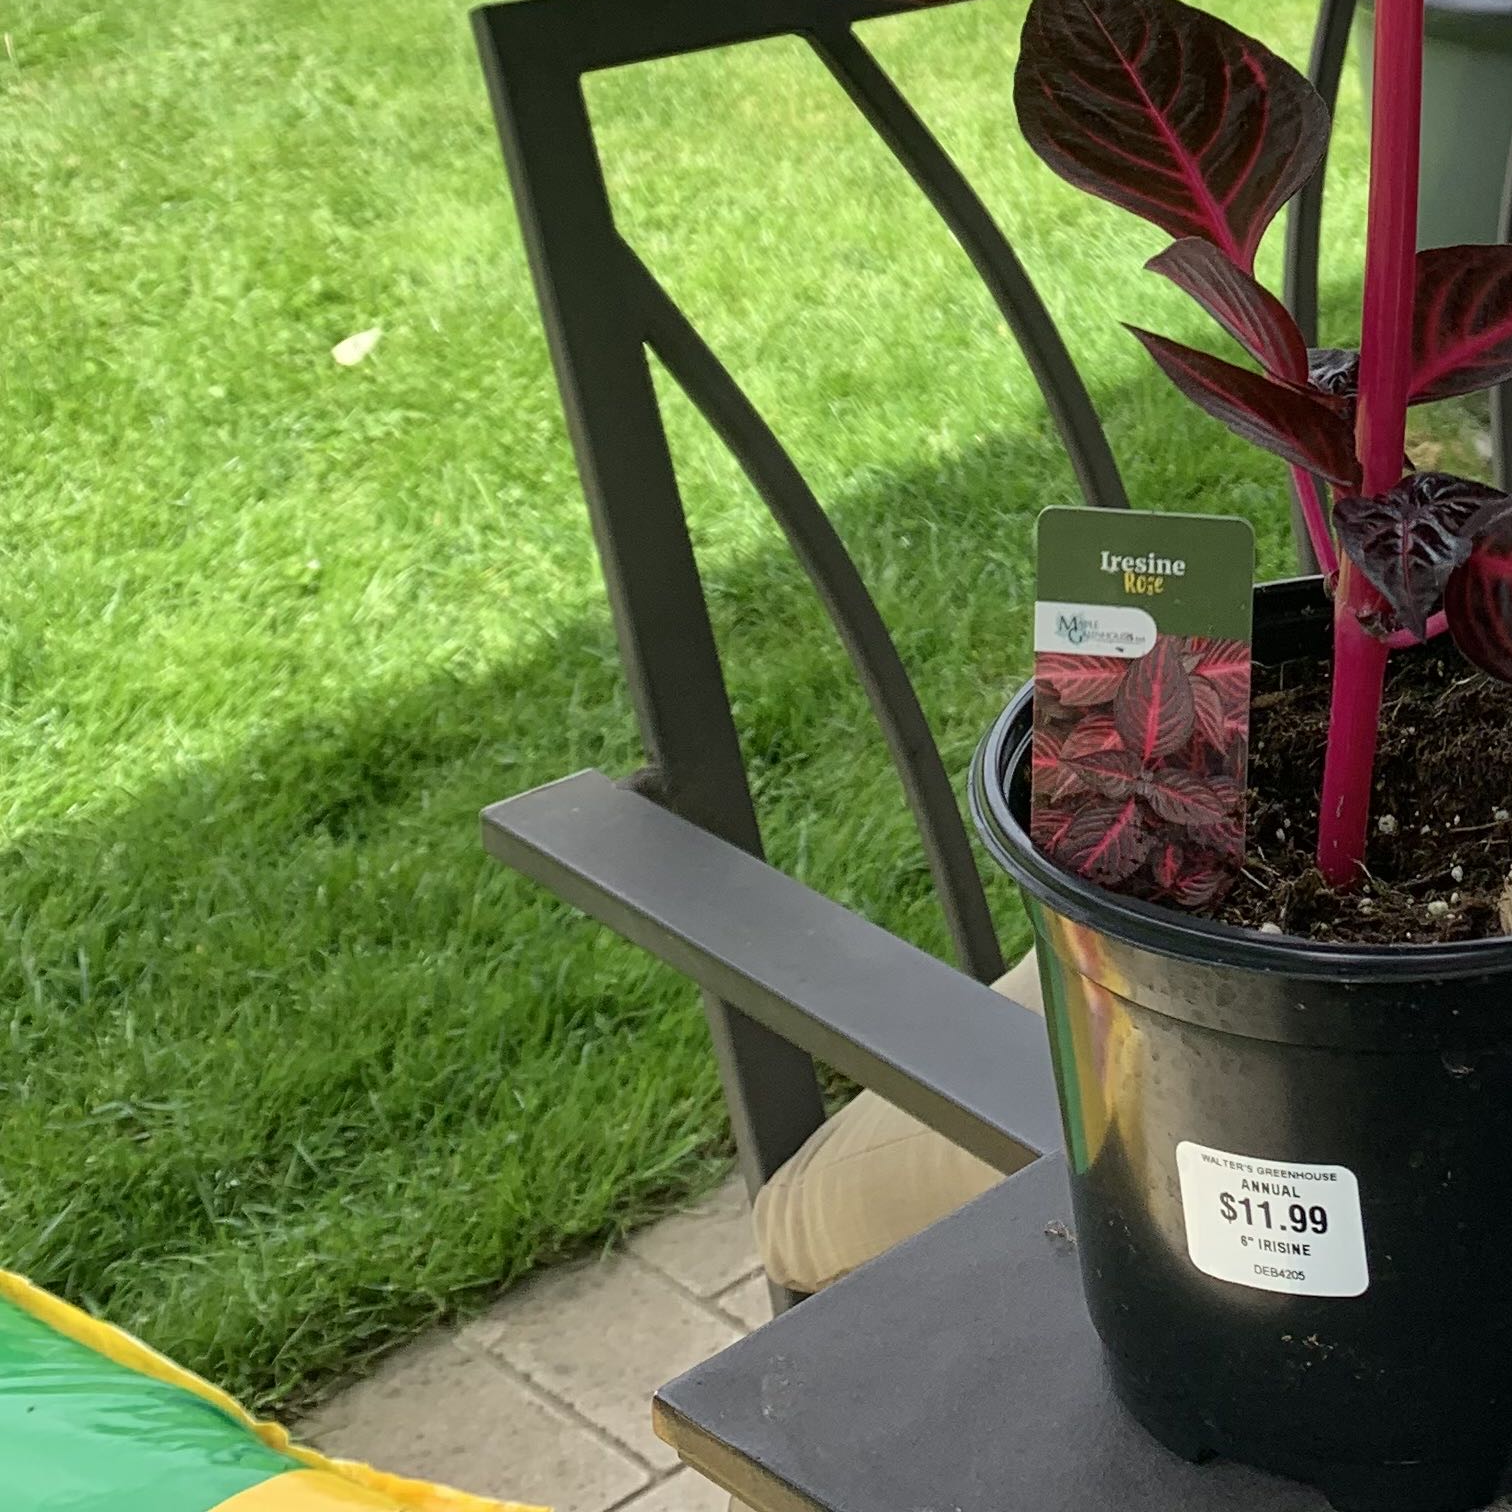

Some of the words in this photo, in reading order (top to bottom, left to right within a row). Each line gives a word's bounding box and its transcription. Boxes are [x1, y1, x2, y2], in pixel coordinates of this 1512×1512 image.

[1100, 550, 1186, 576] Iresine
[1123, 572, 1165, 595] Rose
[1201, 1153, 1253, 1173] WALTER'S
[1257, 1167, 1338, 1182] GREENHOUSE
[1241, 1178, 1301, 1198] ANNUAL
[1219, 1191, 1328, 1234] $11.99
[1258, 1238, 1311, 1256] IRISINE
[1254, 1264, 1306, 1281] DEB4205
